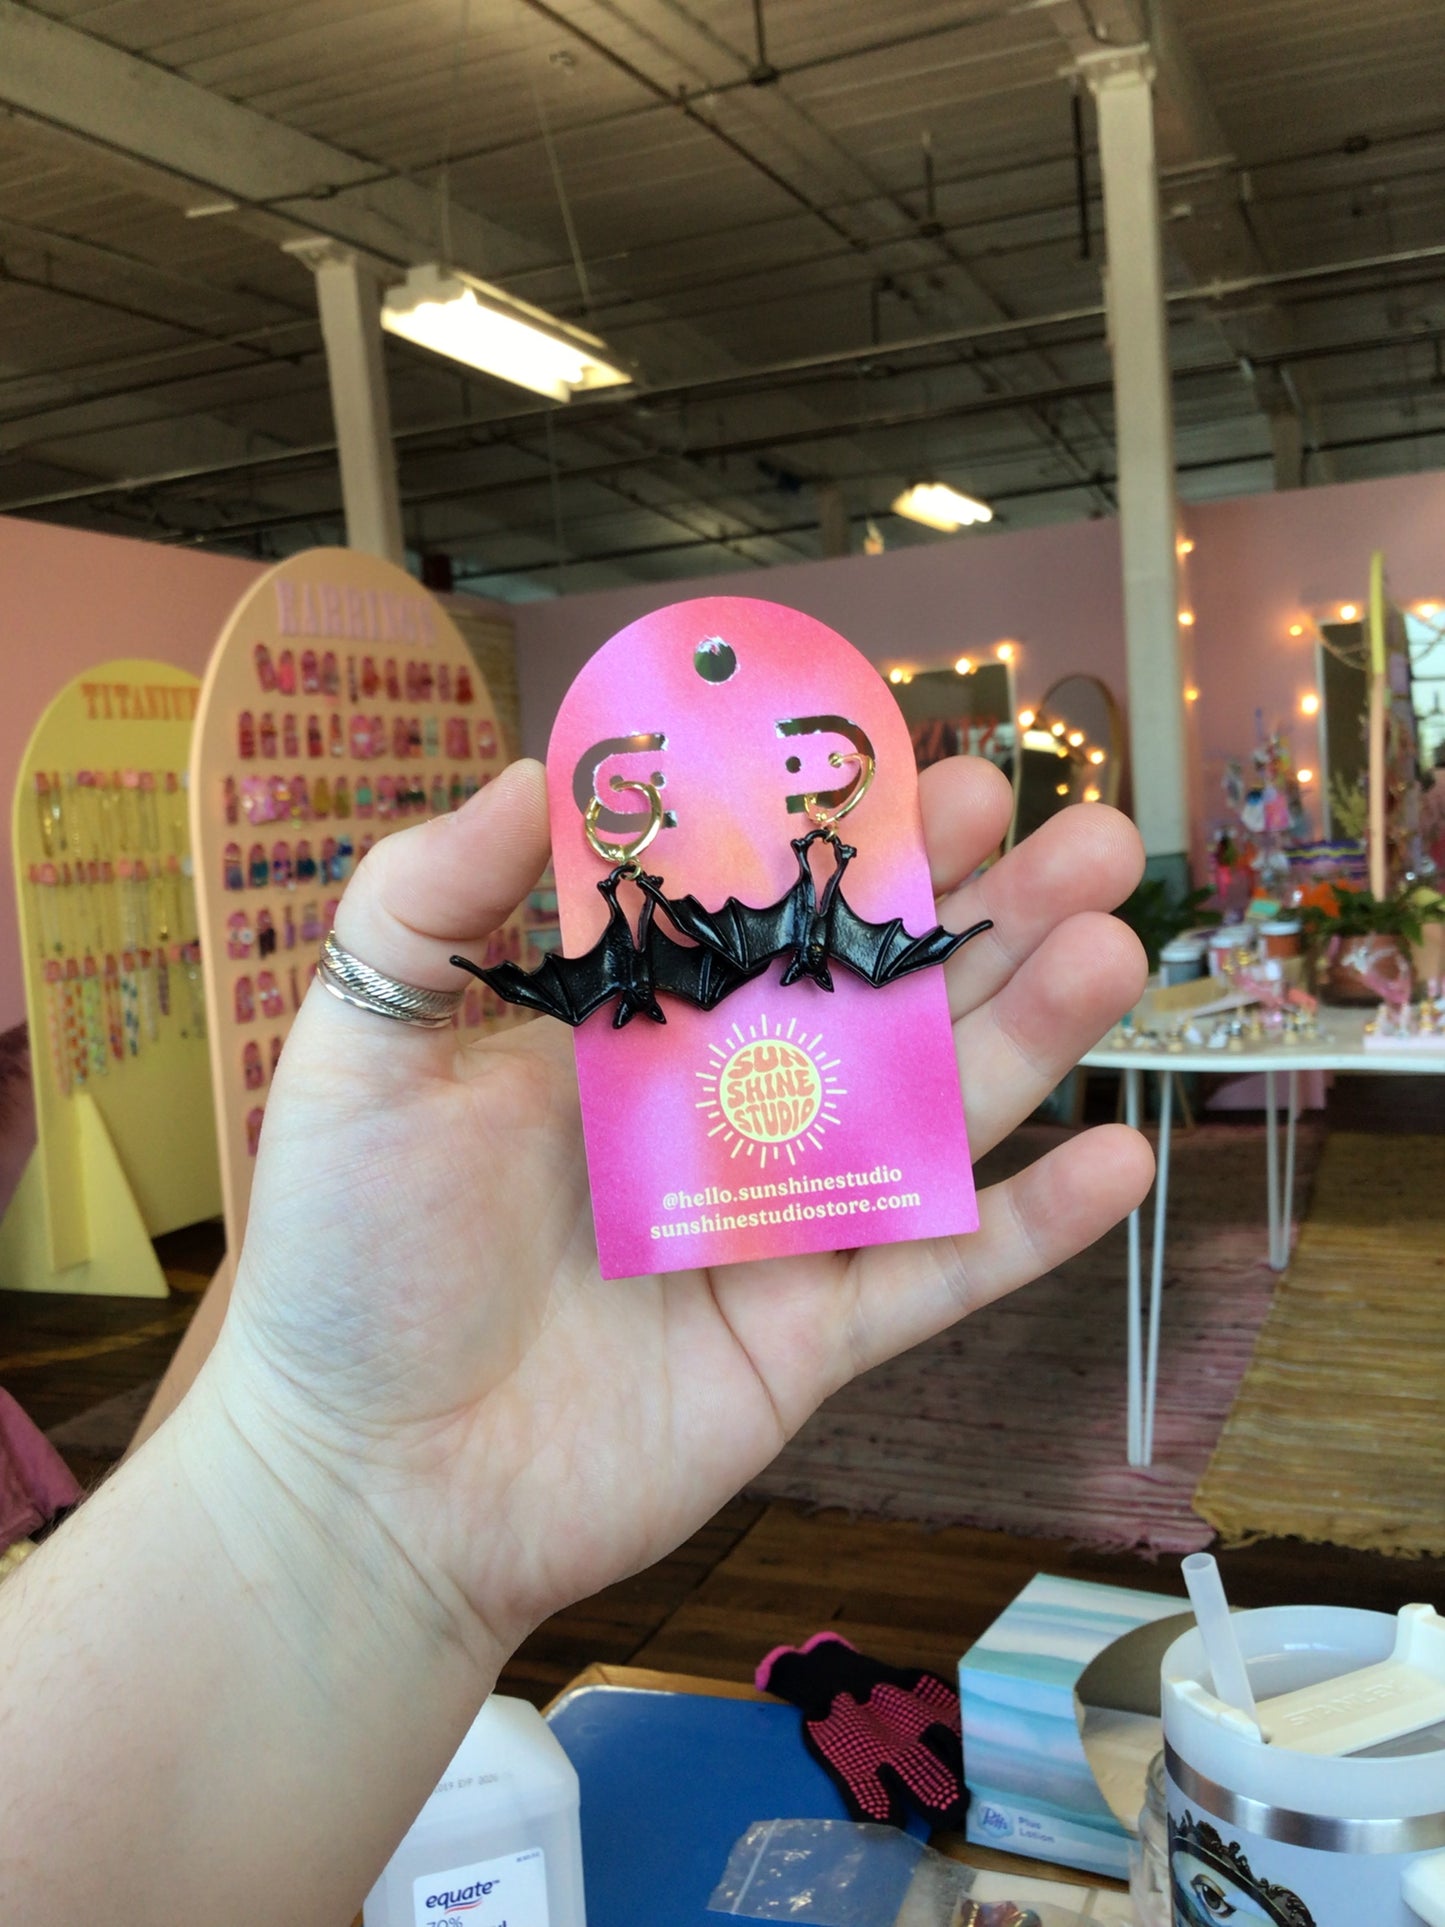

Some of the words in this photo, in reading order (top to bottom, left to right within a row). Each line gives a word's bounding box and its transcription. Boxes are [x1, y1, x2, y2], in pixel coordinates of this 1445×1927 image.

[727, 1046, 809, 1079] SUN
[727, 1069, 816, 1109] SHINE
[733, 1098, 815, 1137] STUDIO
[662, 1166, 902, 1211] @hello.sunshinestudio
[651, 1192, 921, 1239] sunshinestudiostore.com
[1019, 1828, 1055, 1843] Lotion
[425, 1881, 493, 1909] equate
